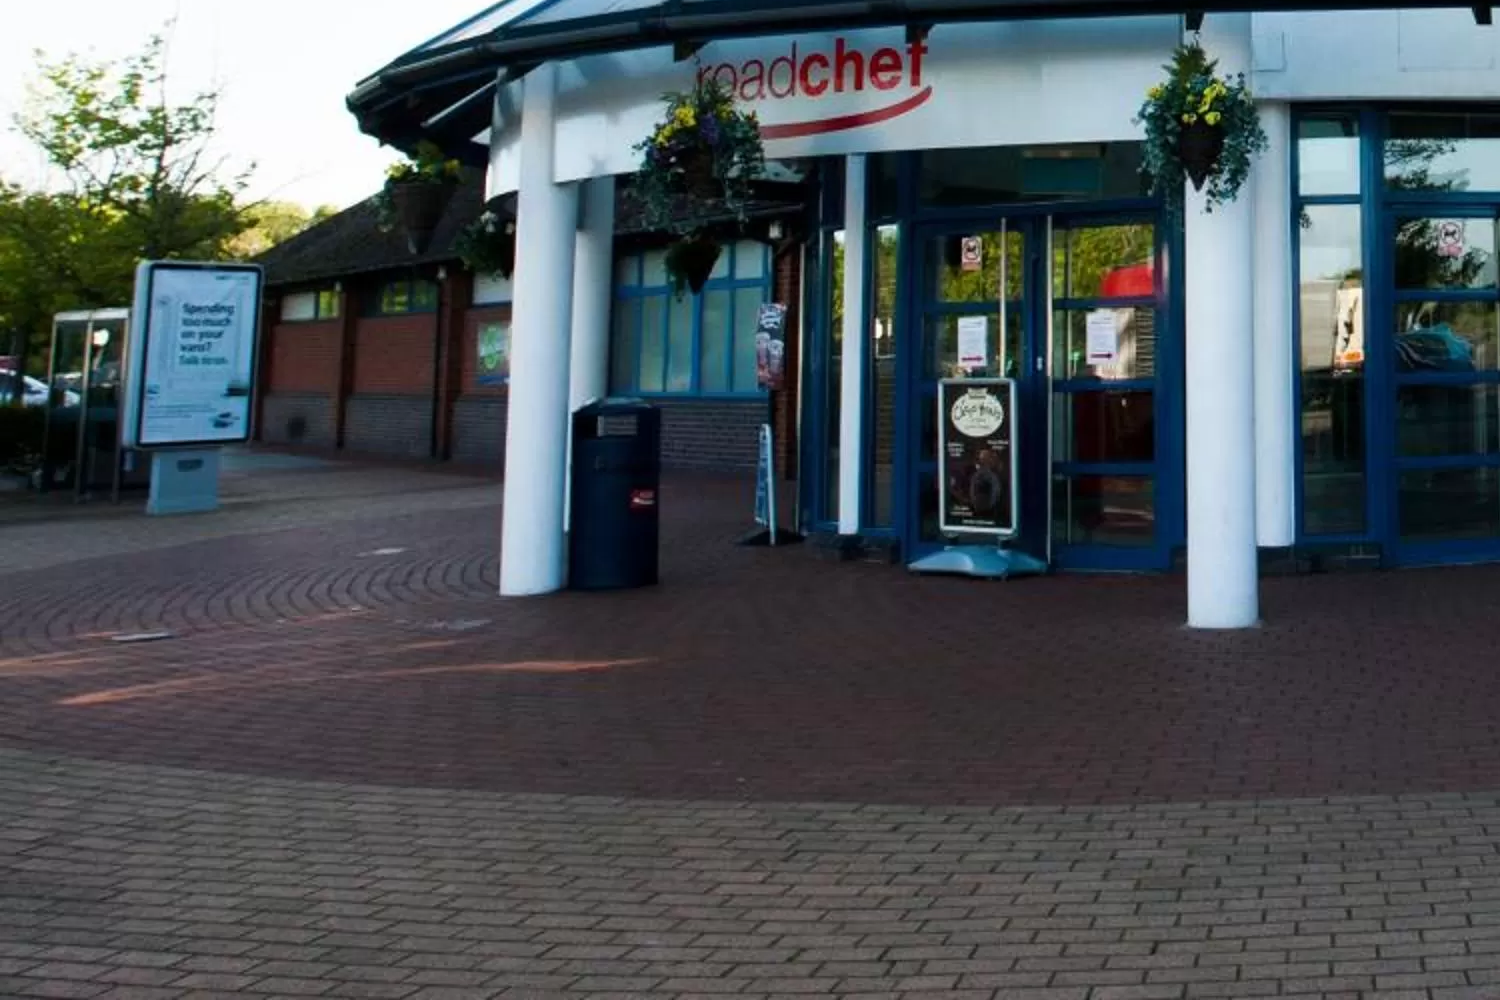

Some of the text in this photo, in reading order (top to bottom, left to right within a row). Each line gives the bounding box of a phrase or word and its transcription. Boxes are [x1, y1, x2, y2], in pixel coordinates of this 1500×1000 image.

[697, 38, 928, 101] roadchef
[182, 303, 235, 316] Spending
[182, 316, 232, 326] too much
[180, 330, 224, 341] on your
